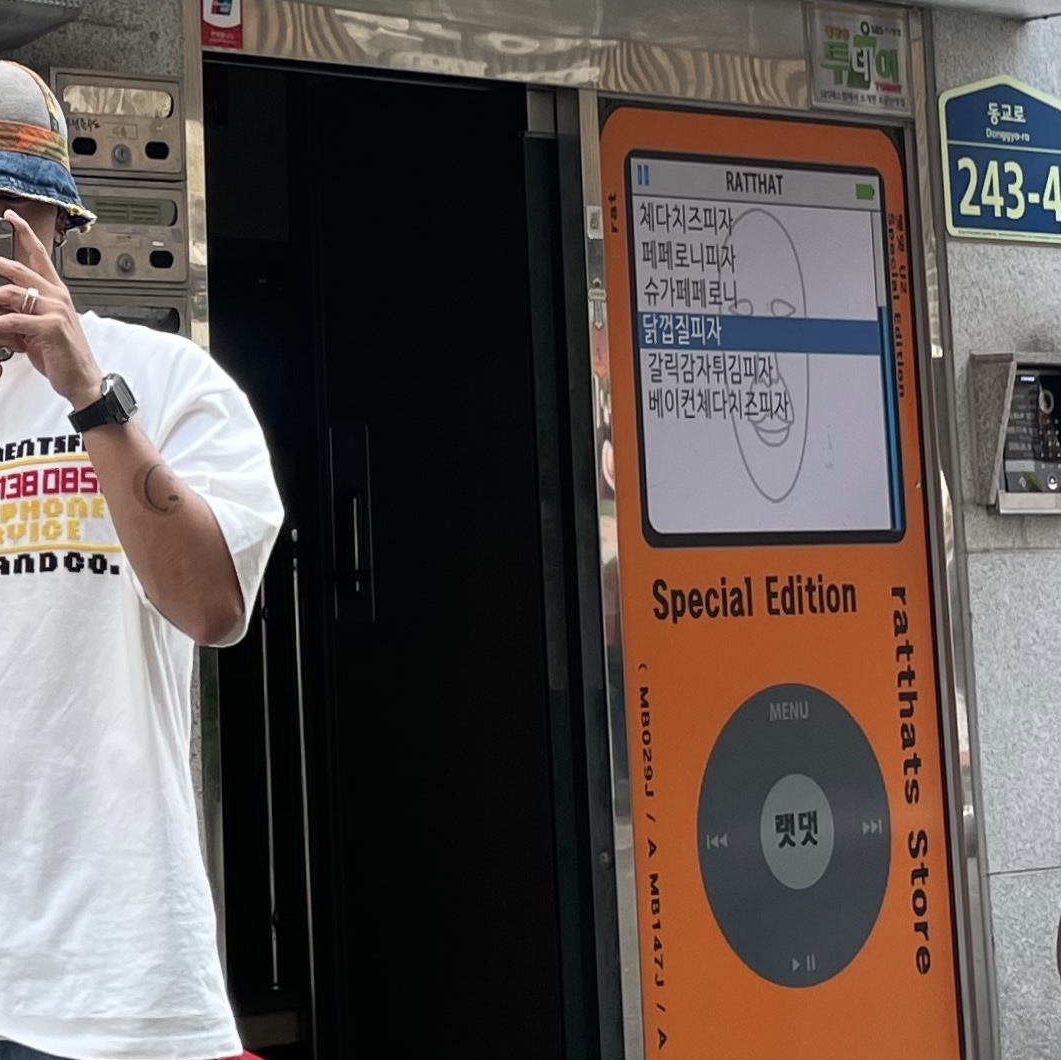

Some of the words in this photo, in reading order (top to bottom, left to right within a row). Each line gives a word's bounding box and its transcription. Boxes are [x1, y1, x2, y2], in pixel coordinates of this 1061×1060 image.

[987, 102, 1026, 126] 동교로
[725, 170, 783, 196] RATTHAT
[639, 202, 734, 237] 체다치즈피자
[641, 239, 736, 274] 페페로니피자
[644, 276, 738, 310] 슈가페페로니
[642, 313, 723, 347] 닭껍질피자
[648, 351, 774, 386] 갈릭감자튀김피자
[894, 312, 905, 398] Edition
[648, 387, 790, 420] 베이컨체다치즈피자
[42, 466, 101, 495] 085
[652, 576, 754, 624] Special
[765, 573, 858, 616] Edition
[769, 700, 810, 722] MENU
[890, 586, 922, 806] ratthats
[907, 828, 932, 975] Store
[639, 686, 655, 798] MB029J
[648, 872, 666, 988] MB147J
[774, 809, 819, 849] 랫댓
